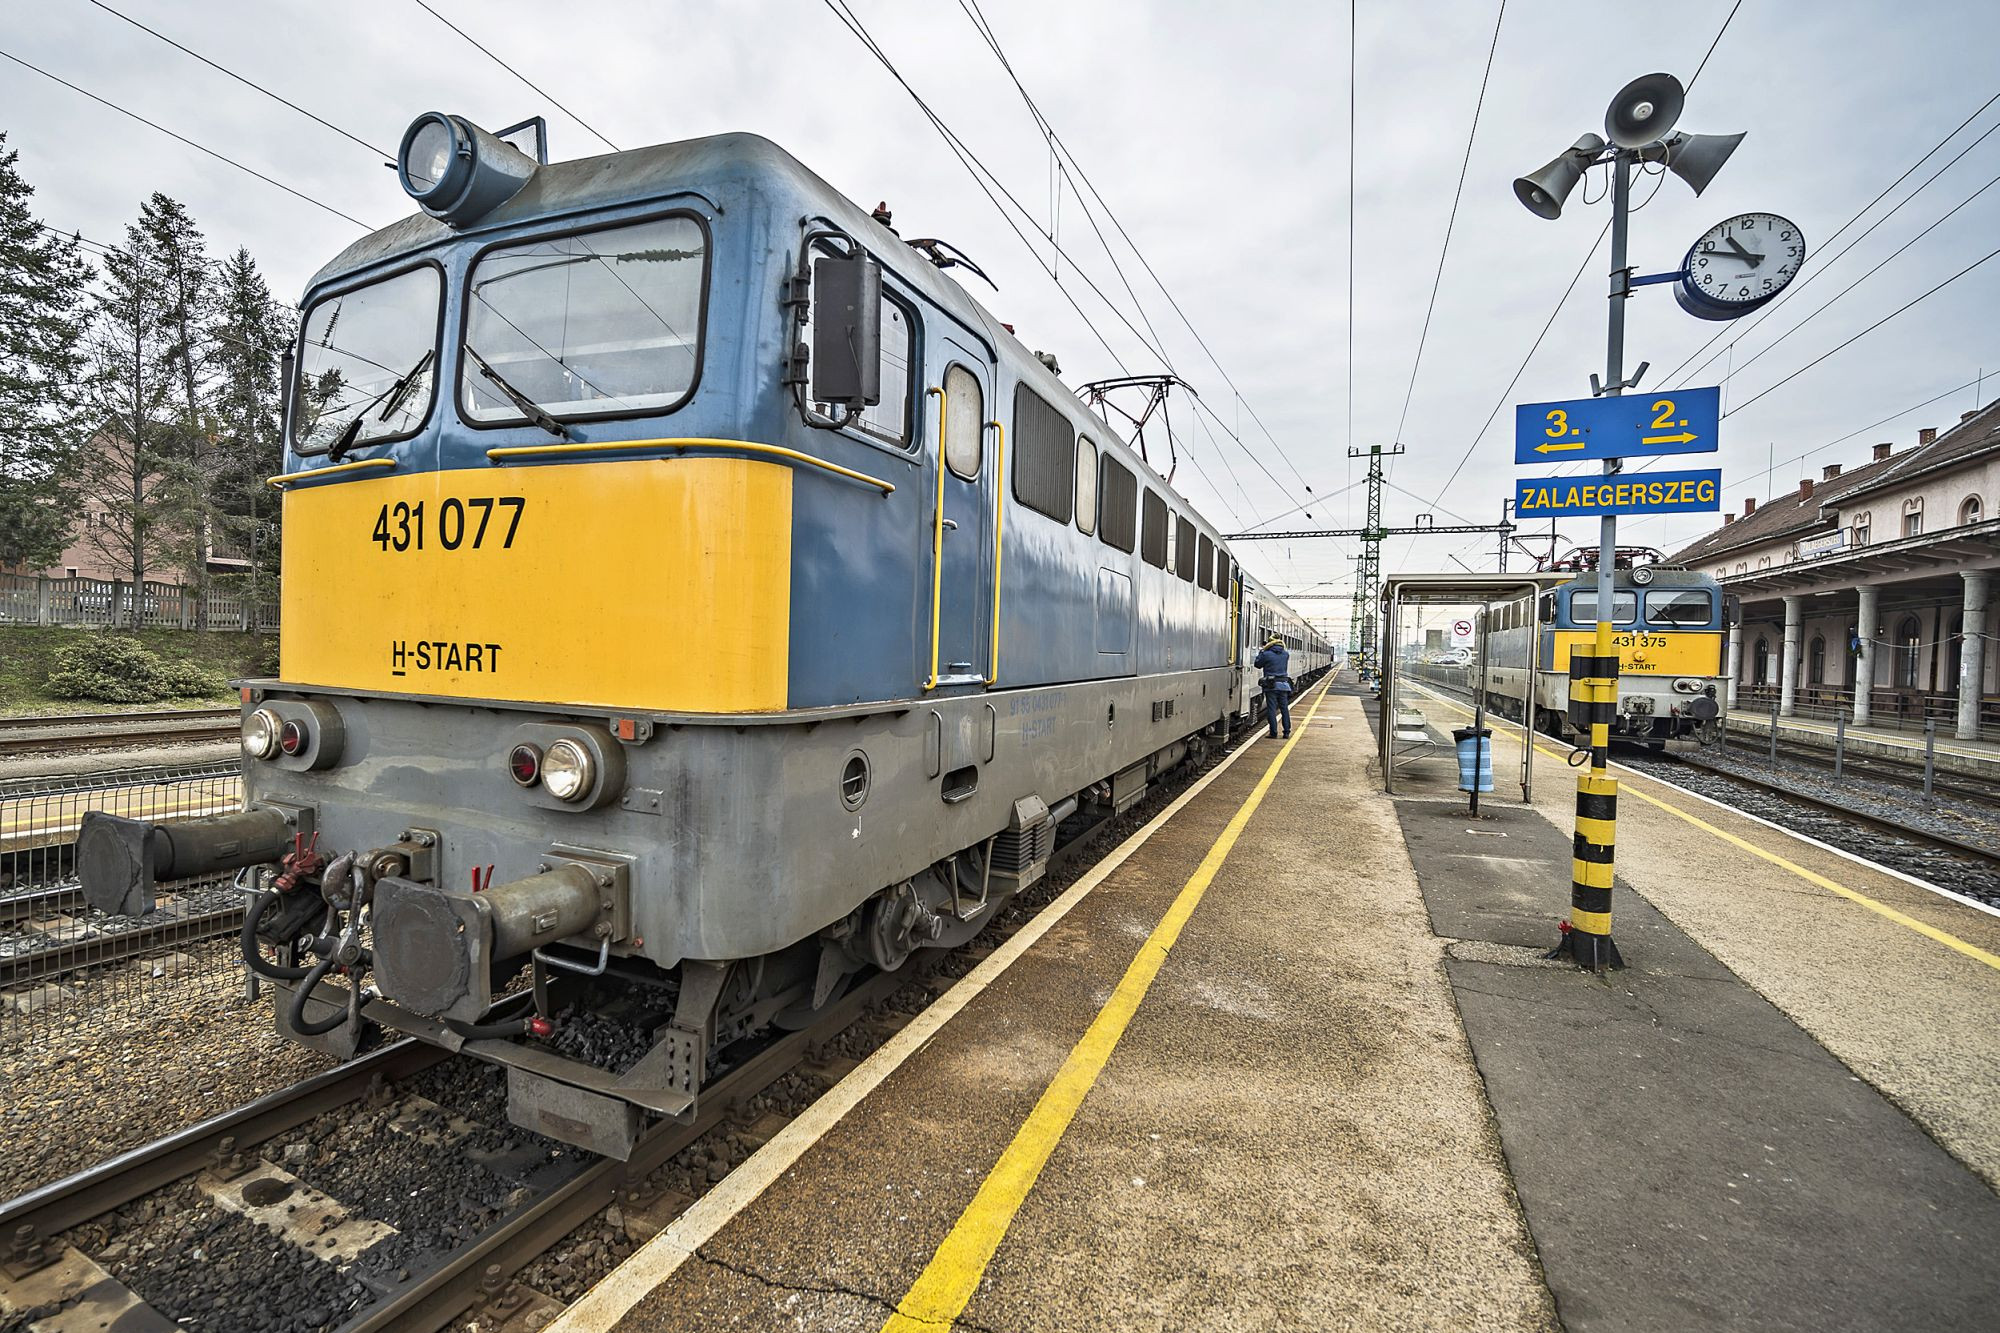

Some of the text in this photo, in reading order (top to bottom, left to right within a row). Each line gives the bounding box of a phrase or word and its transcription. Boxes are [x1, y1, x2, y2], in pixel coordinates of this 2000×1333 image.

[1741, 219, 1754, 230] 12
[1768, 220, 1772, 231] 1
[1721, 226, 1731, 238] 11
[1780, 230, 1791, 241] 2
[1703, 240, 1716, 252] 10
[1787, 246, 1797, 257] 3
[1698, 258, 1708, 269] 9
[1776, 264, 1788, 275] 4
[1703, 273, 1713, 285] 8
[1762, 278, 1773, 290] 5
[1718, 283, 1728, 295] 7
[1739, 286, 1750, 297] 6
[1650, 399, 1689, 430] 2.
[1545, 409, 1580, 438] 3.
[1521, 479, 1715, 510] ZALAEGERSZEG
[372, 496, 527, 552] 431 077
[1612, 636, 1667, 648] 431 375
[392, 640, 503, 676] H-START
[1022, 716, 1057, 742] H-START
